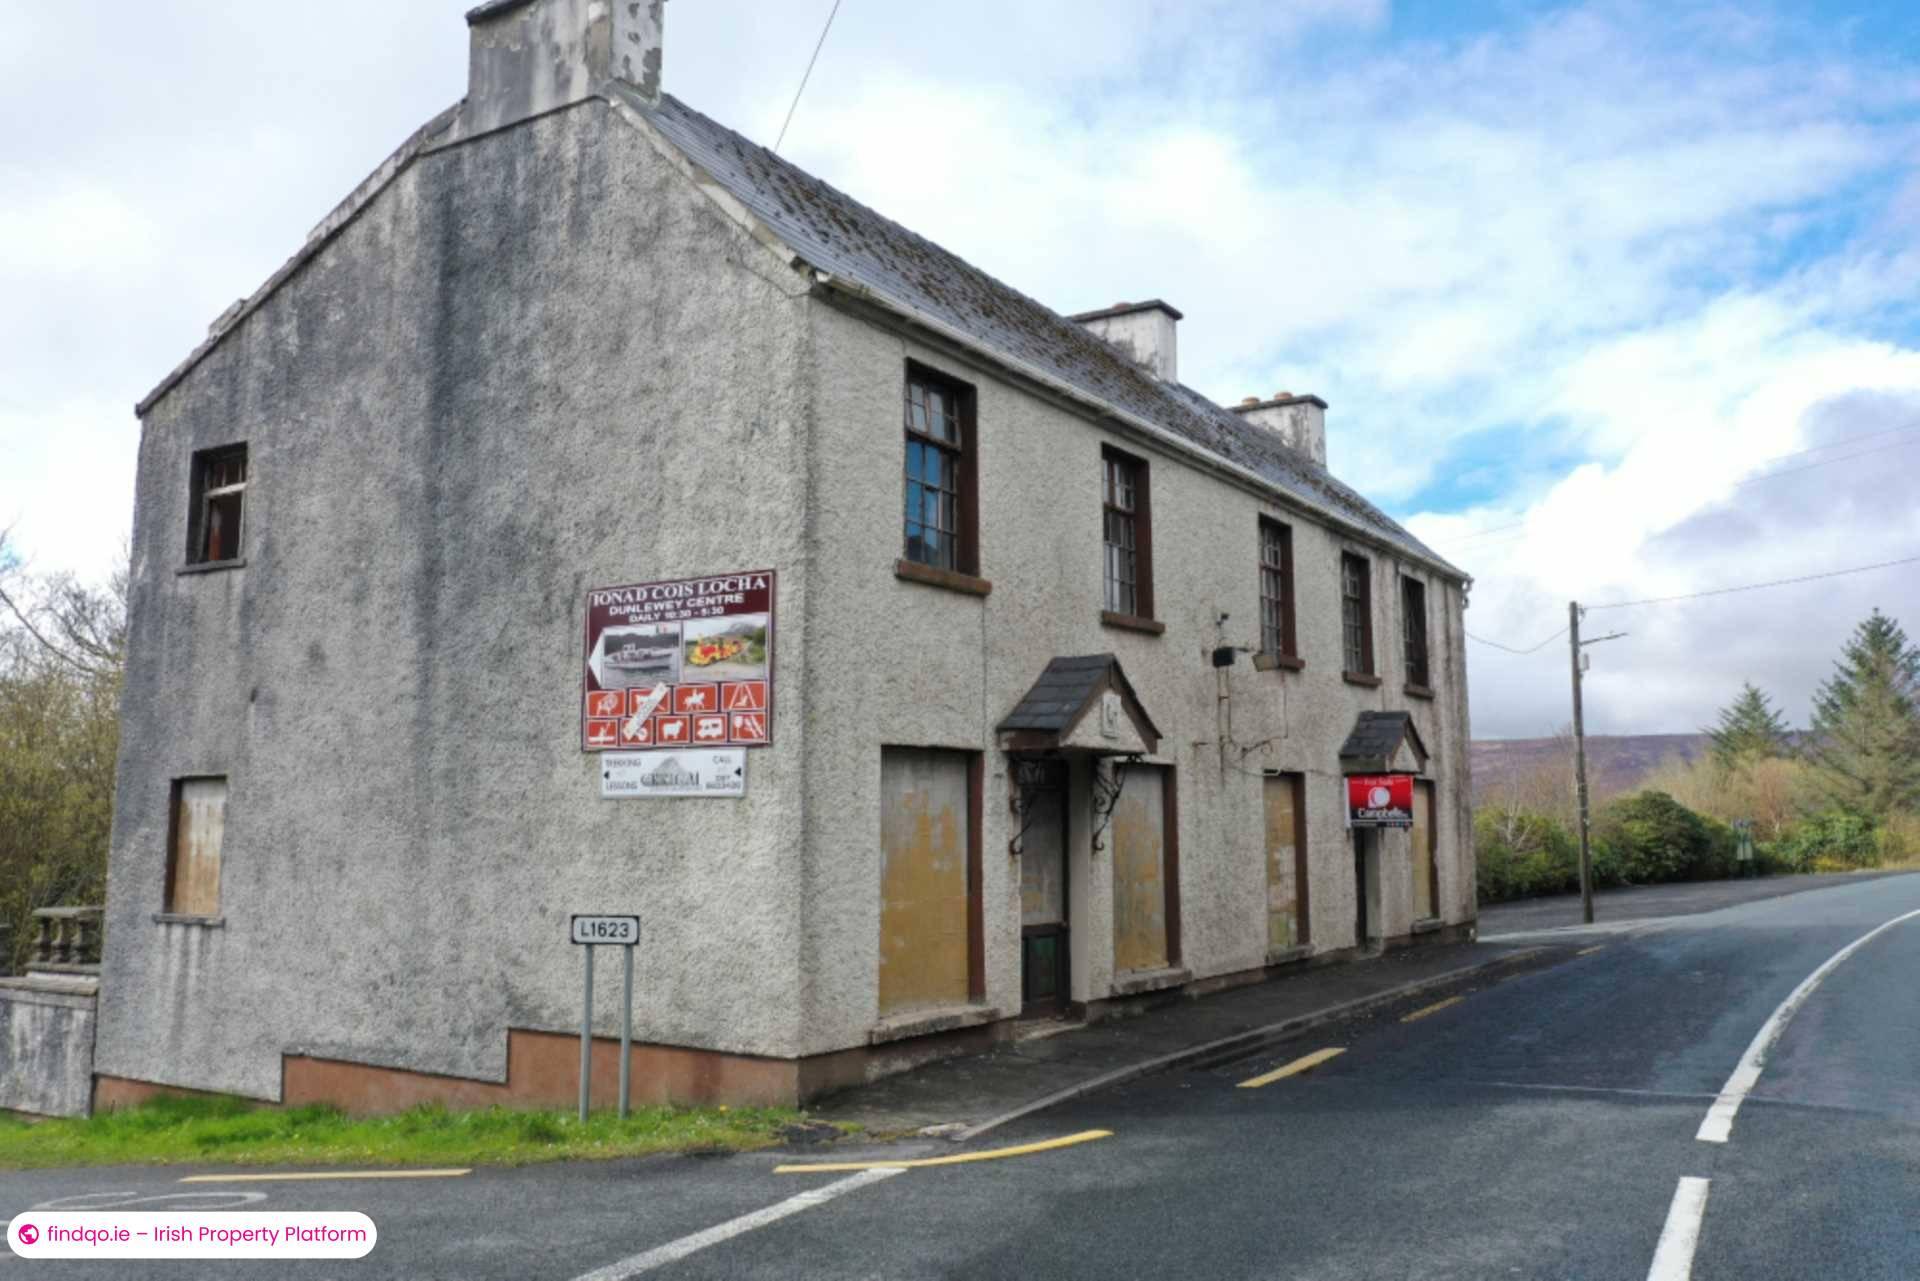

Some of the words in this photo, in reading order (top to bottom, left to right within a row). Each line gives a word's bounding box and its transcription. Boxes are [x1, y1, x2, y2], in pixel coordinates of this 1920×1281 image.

[593, 589, 648, 607] IONAD
[651, 583, 694, 600] COIS
[699, 575, 767, 595] LOCHA
[609, 599, 684, 616] DUNLEWEY
[686, 593, 745, 608] CENTRE
[628, 613, 661, 623] DAILY
[581, 921, 629, 938] L1623
